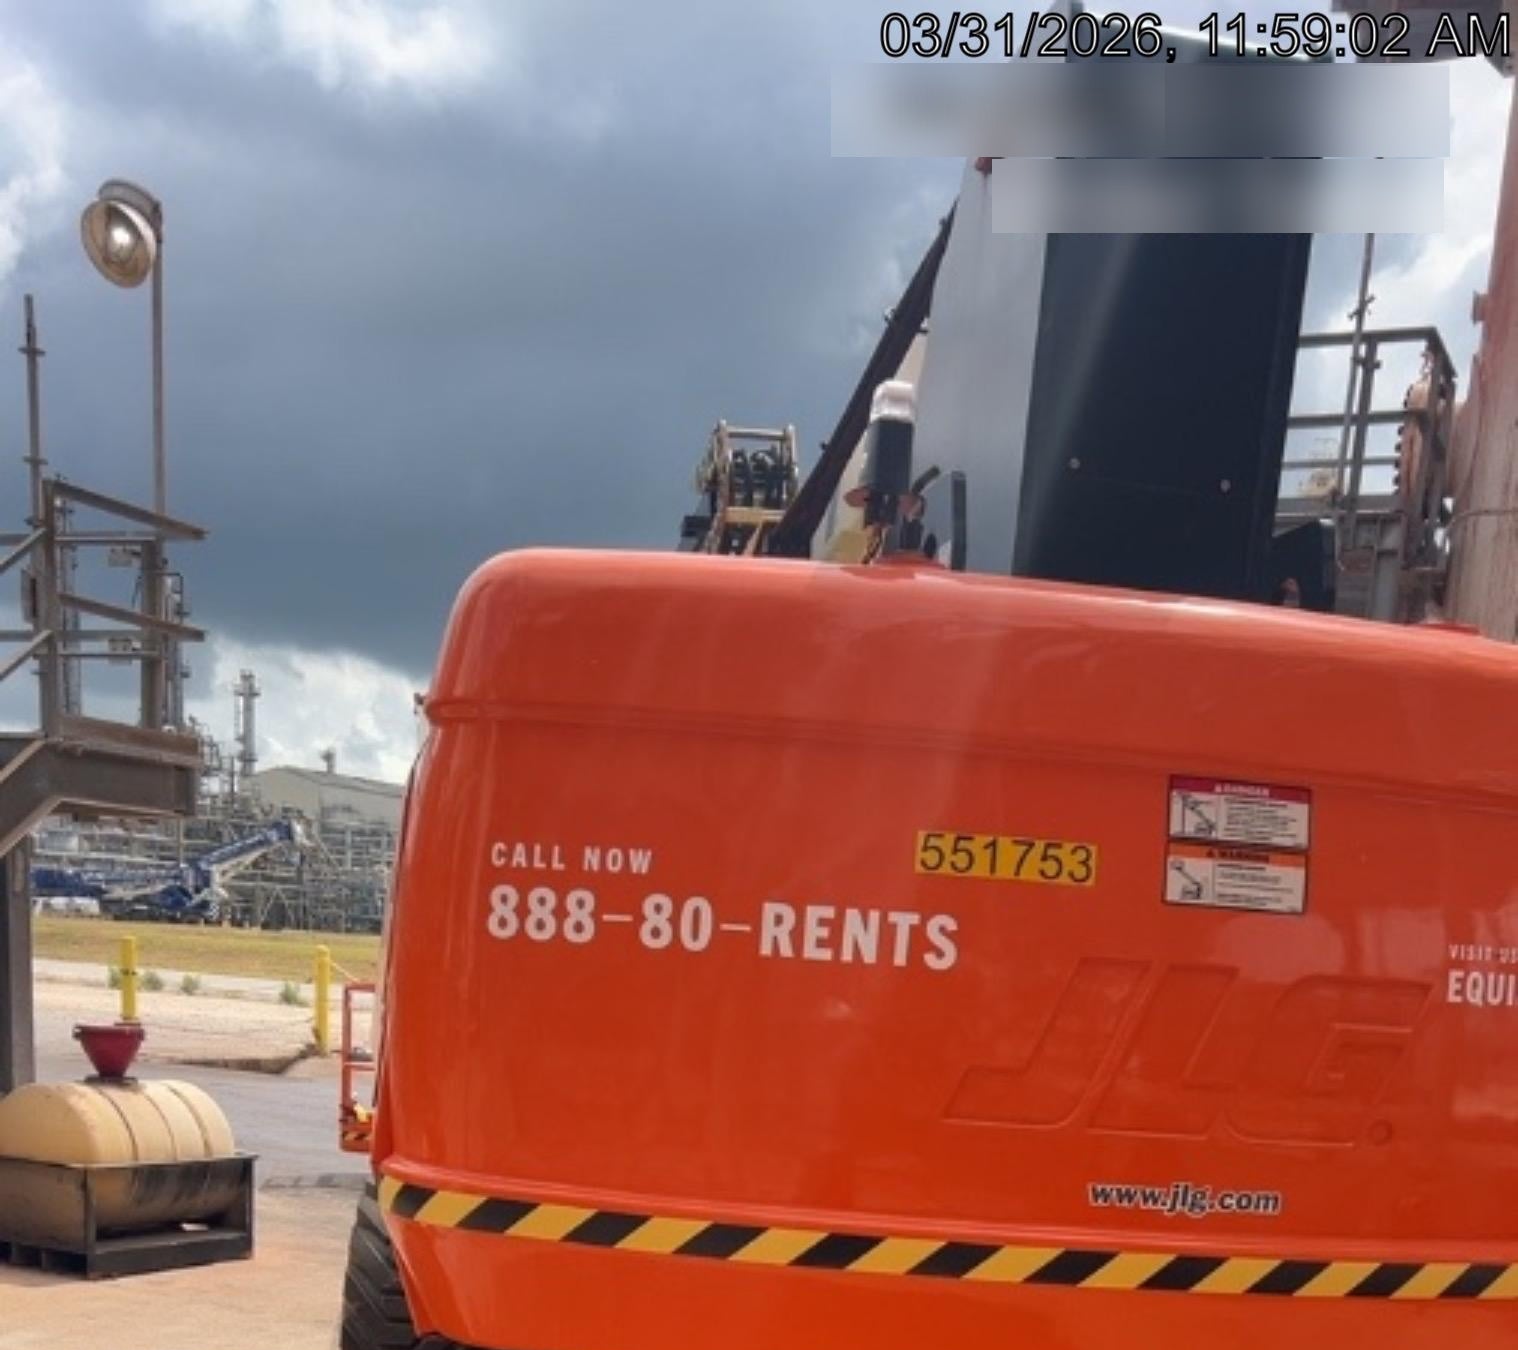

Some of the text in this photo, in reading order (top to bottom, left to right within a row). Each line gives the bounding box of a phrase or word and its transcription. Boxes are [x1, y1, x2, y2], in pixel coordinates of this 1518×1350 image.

[491, 842, 653, 874] CALL NOW
[920, 833, 1093, 883] 551753
[487, 884, 959, 970] 888-80-RENTS
[1447, 969, 1518, 1006] EQUI
[941, 957, 1433, 1147] JLG
[1088, 1182, 1281, 1218] www.jlg.com
